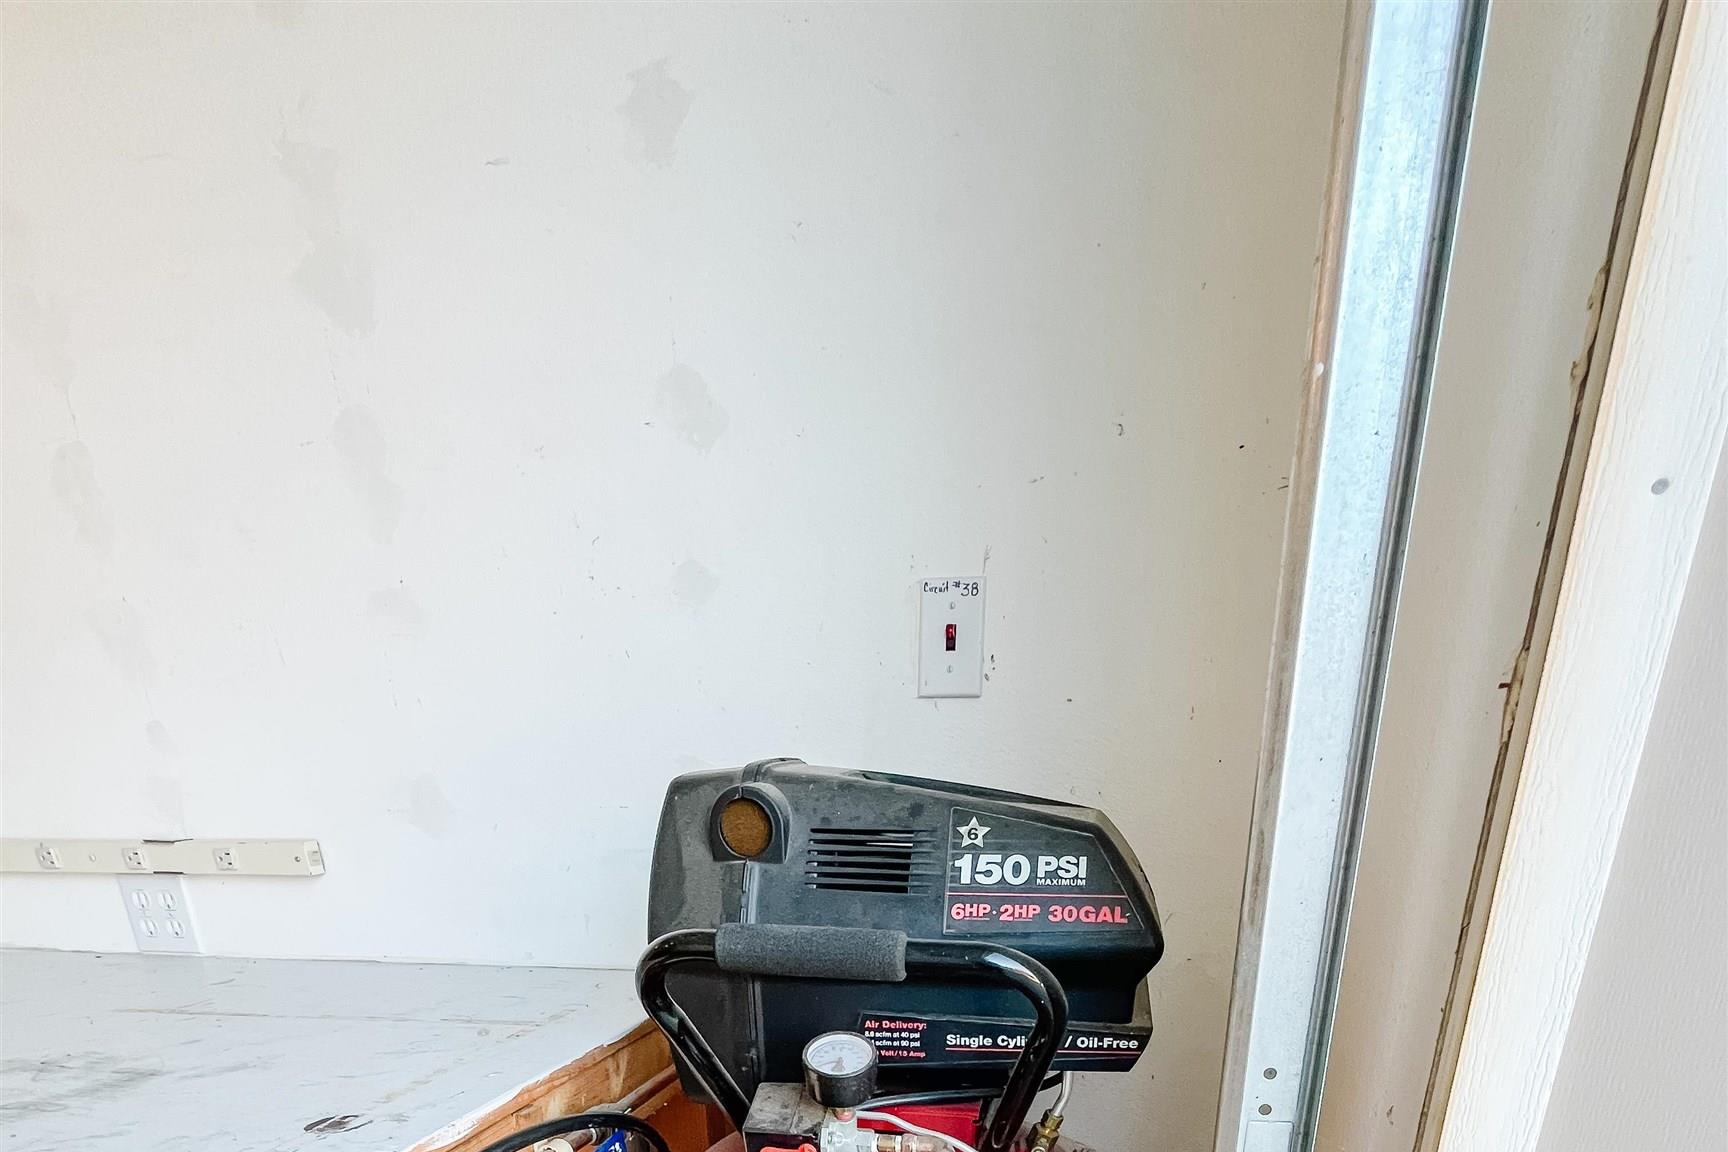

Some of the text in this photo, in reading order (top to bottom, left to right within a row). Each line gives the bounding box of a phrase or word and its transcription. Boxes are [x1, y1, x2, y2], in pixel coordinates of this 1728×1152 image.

[923, 580, 949, 593] Circuit
[967, 827, 979, 841] 6
[954, 853, 1088, 886] 150 PSI
[1036, 878, 1086, 886] MAXIMUM
[1048, 905, 1129, 924] 30GAL
[864, 1020, 927, 1030] Air Delivery:
[910, 1031, 920, 1039] psi
[945, 1034, 993, 1047] Single
[1076, 1036, 1139, 1049] Oil-Free
[910, 1040, 920, 1048] psi
